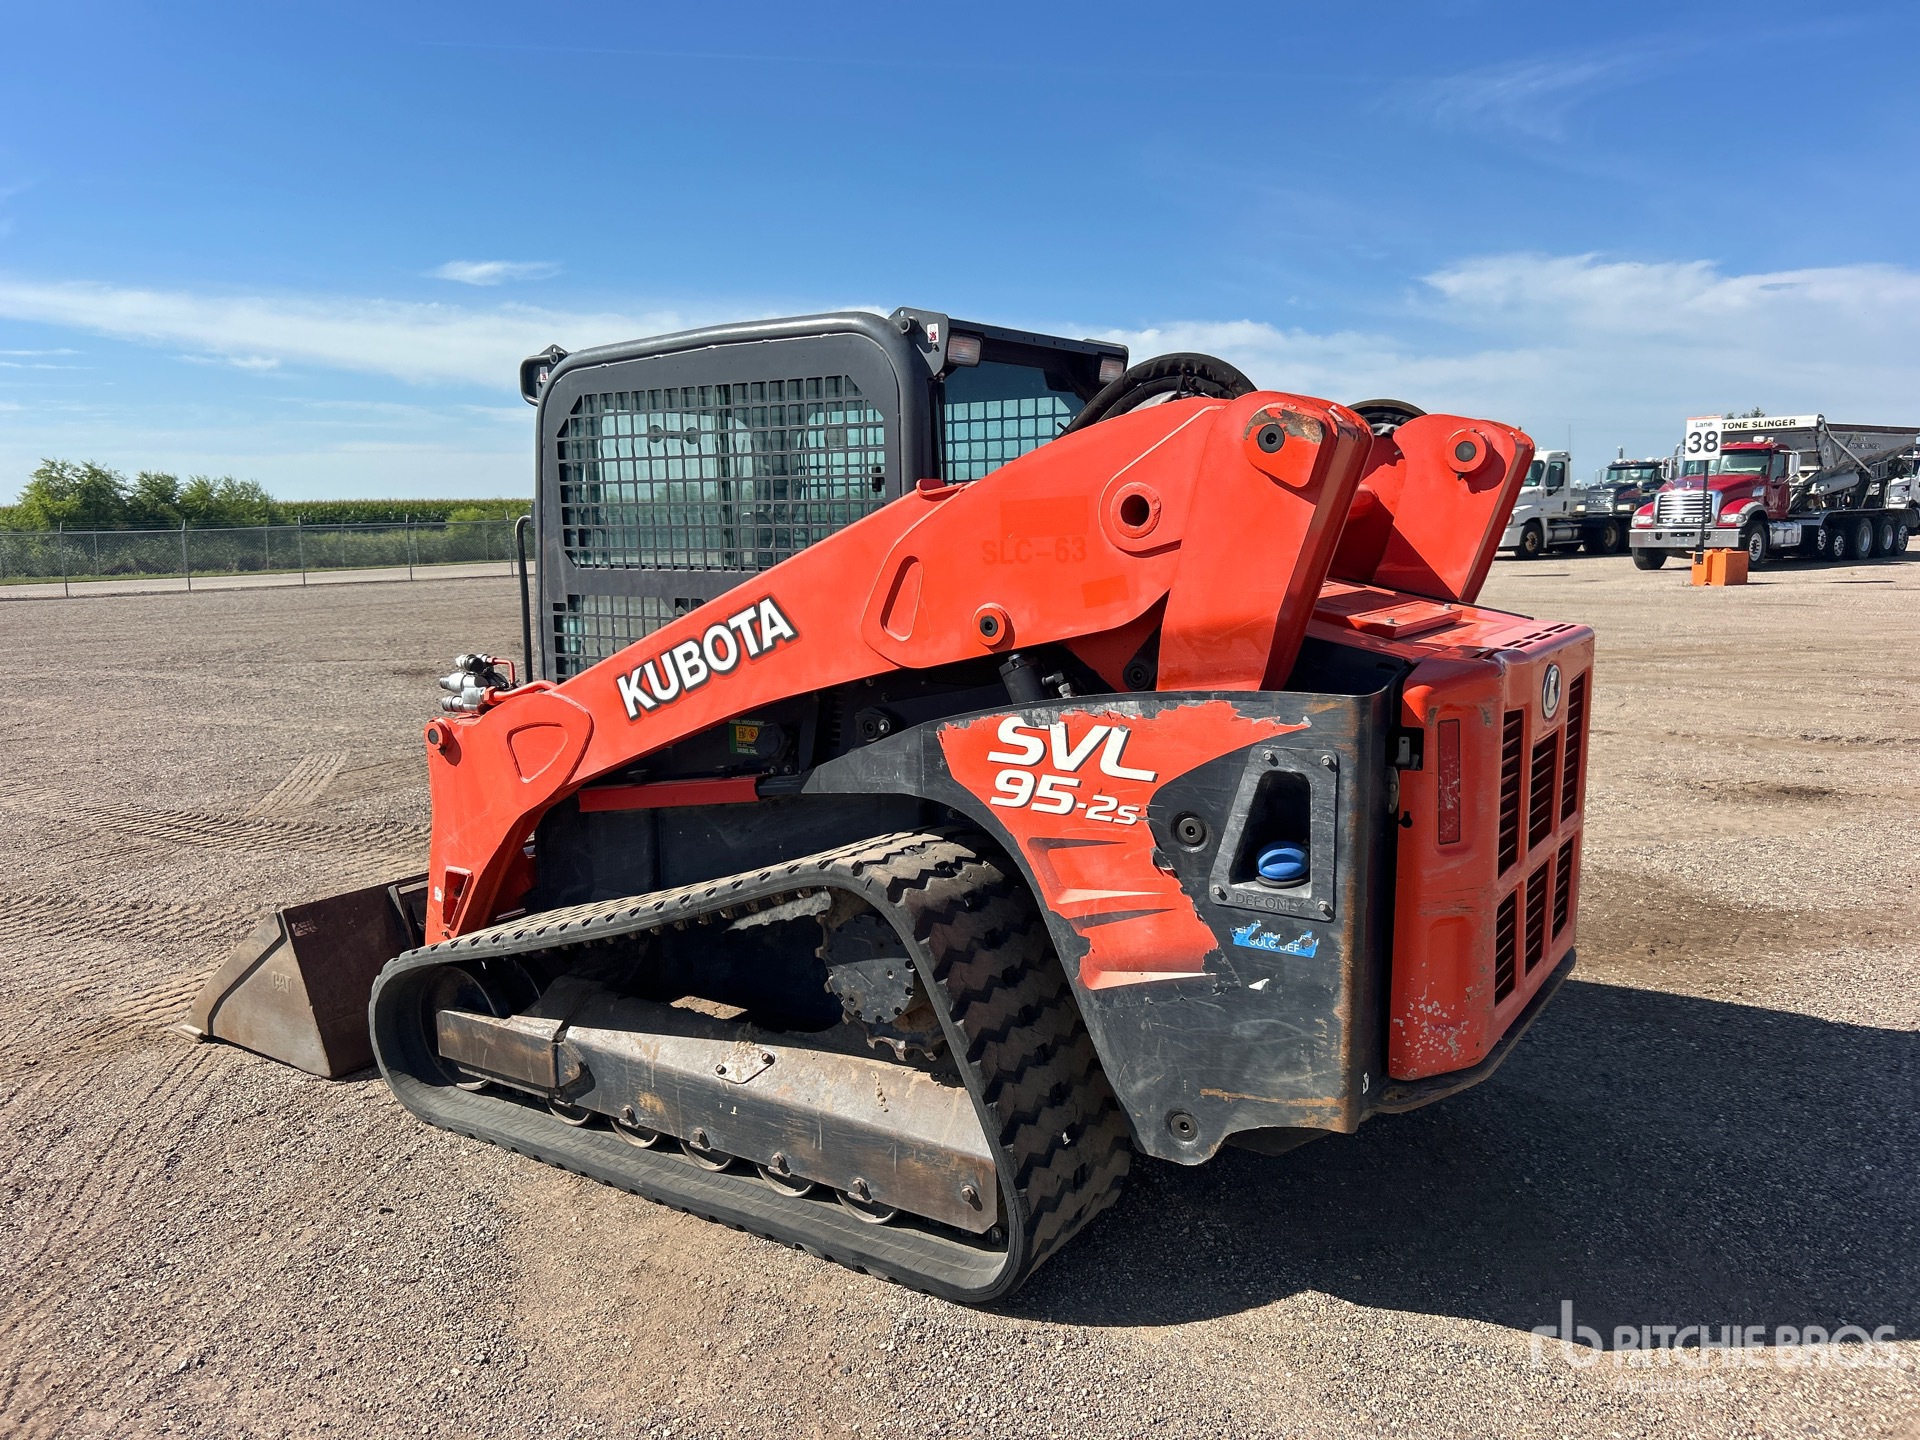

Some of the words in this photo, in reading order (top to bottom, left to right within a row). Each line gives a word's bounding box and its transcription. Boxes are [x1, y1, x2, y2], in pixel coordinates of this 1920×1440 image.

[1752, 419, 1796, 428] SLINGER
[1687, 430, 1719, 454] 38
[981, 536, 1087, 566] SLC-63
[616, 597, 797, 719] KUBOTA
[987, 716, 1158, 783] SVL
[1235, 891, 1261, 907] DEF
[1265, 897, 1304, 912] ONLY
